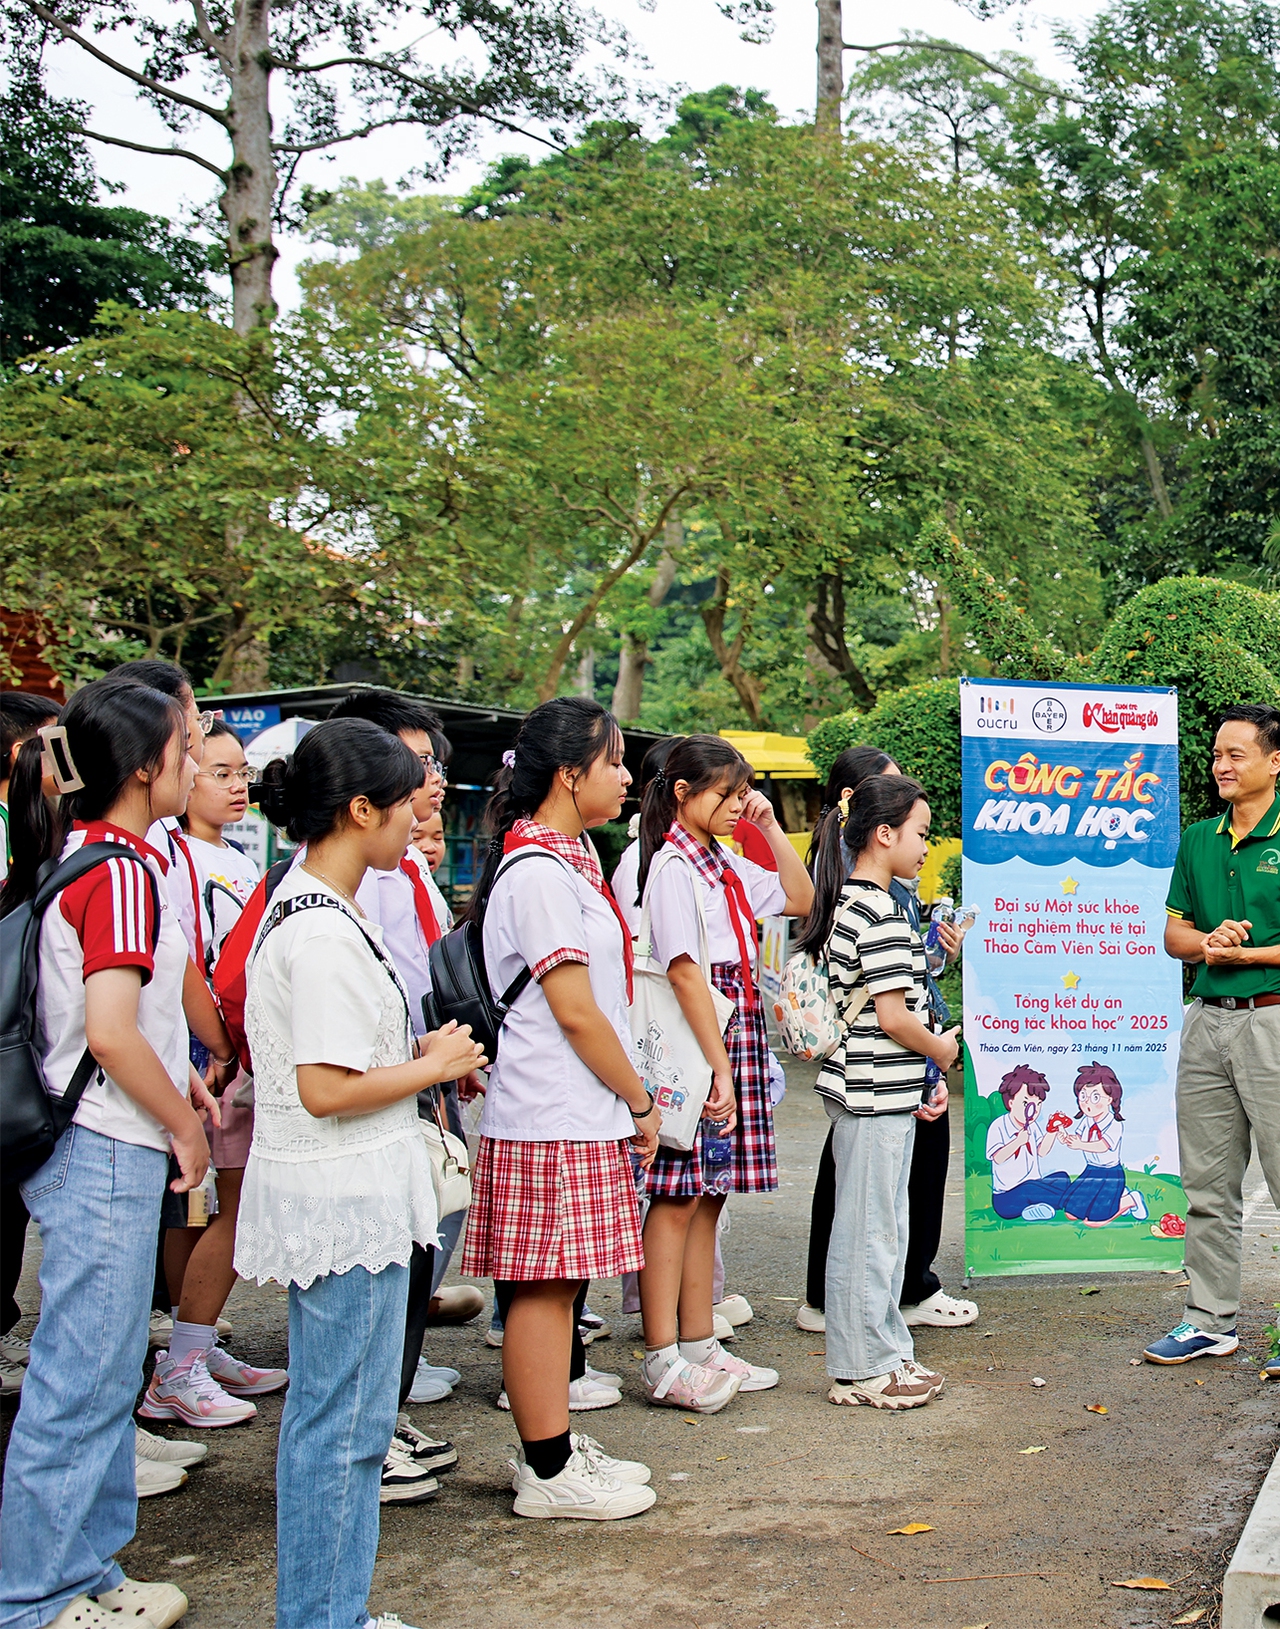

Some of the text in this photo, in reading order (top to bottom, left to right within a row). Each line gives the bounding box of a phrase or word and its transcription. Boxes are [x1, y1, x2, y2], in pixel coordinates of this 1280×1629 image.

[230, 706, 266, 722] VÀO
[977, 716, 1018, 730] oucru
[984, 751, 1161, 804] CÔNG TẮC
[973, 798, 1156, 850] KHOA HỌC
[994, 897, 1140, 916] Đại sứ Một sức khỏe
[988, 918, 1147, 937] trải nghiệm thực tế tại
[984, 937, 1156, 955] Thảo Cầm Viên Sài Gòn
[1014, 992, 1122, 1013] Tổng kết dự án
[1024, 1014, 1046, 1030] tắc
[1050, 1014, 1087, 1030] khoa
[1130, 1015, 1168, 1030] 2025
[642, 1037, 664, 1062] HELLO
[1071, 1043, 1083, 1052] 23
[1084, 1042, 1108, 1055] tháng
[1111, 1043, 1121, 1052] 11
[1145, 1043, 1168, 1052] 2025
